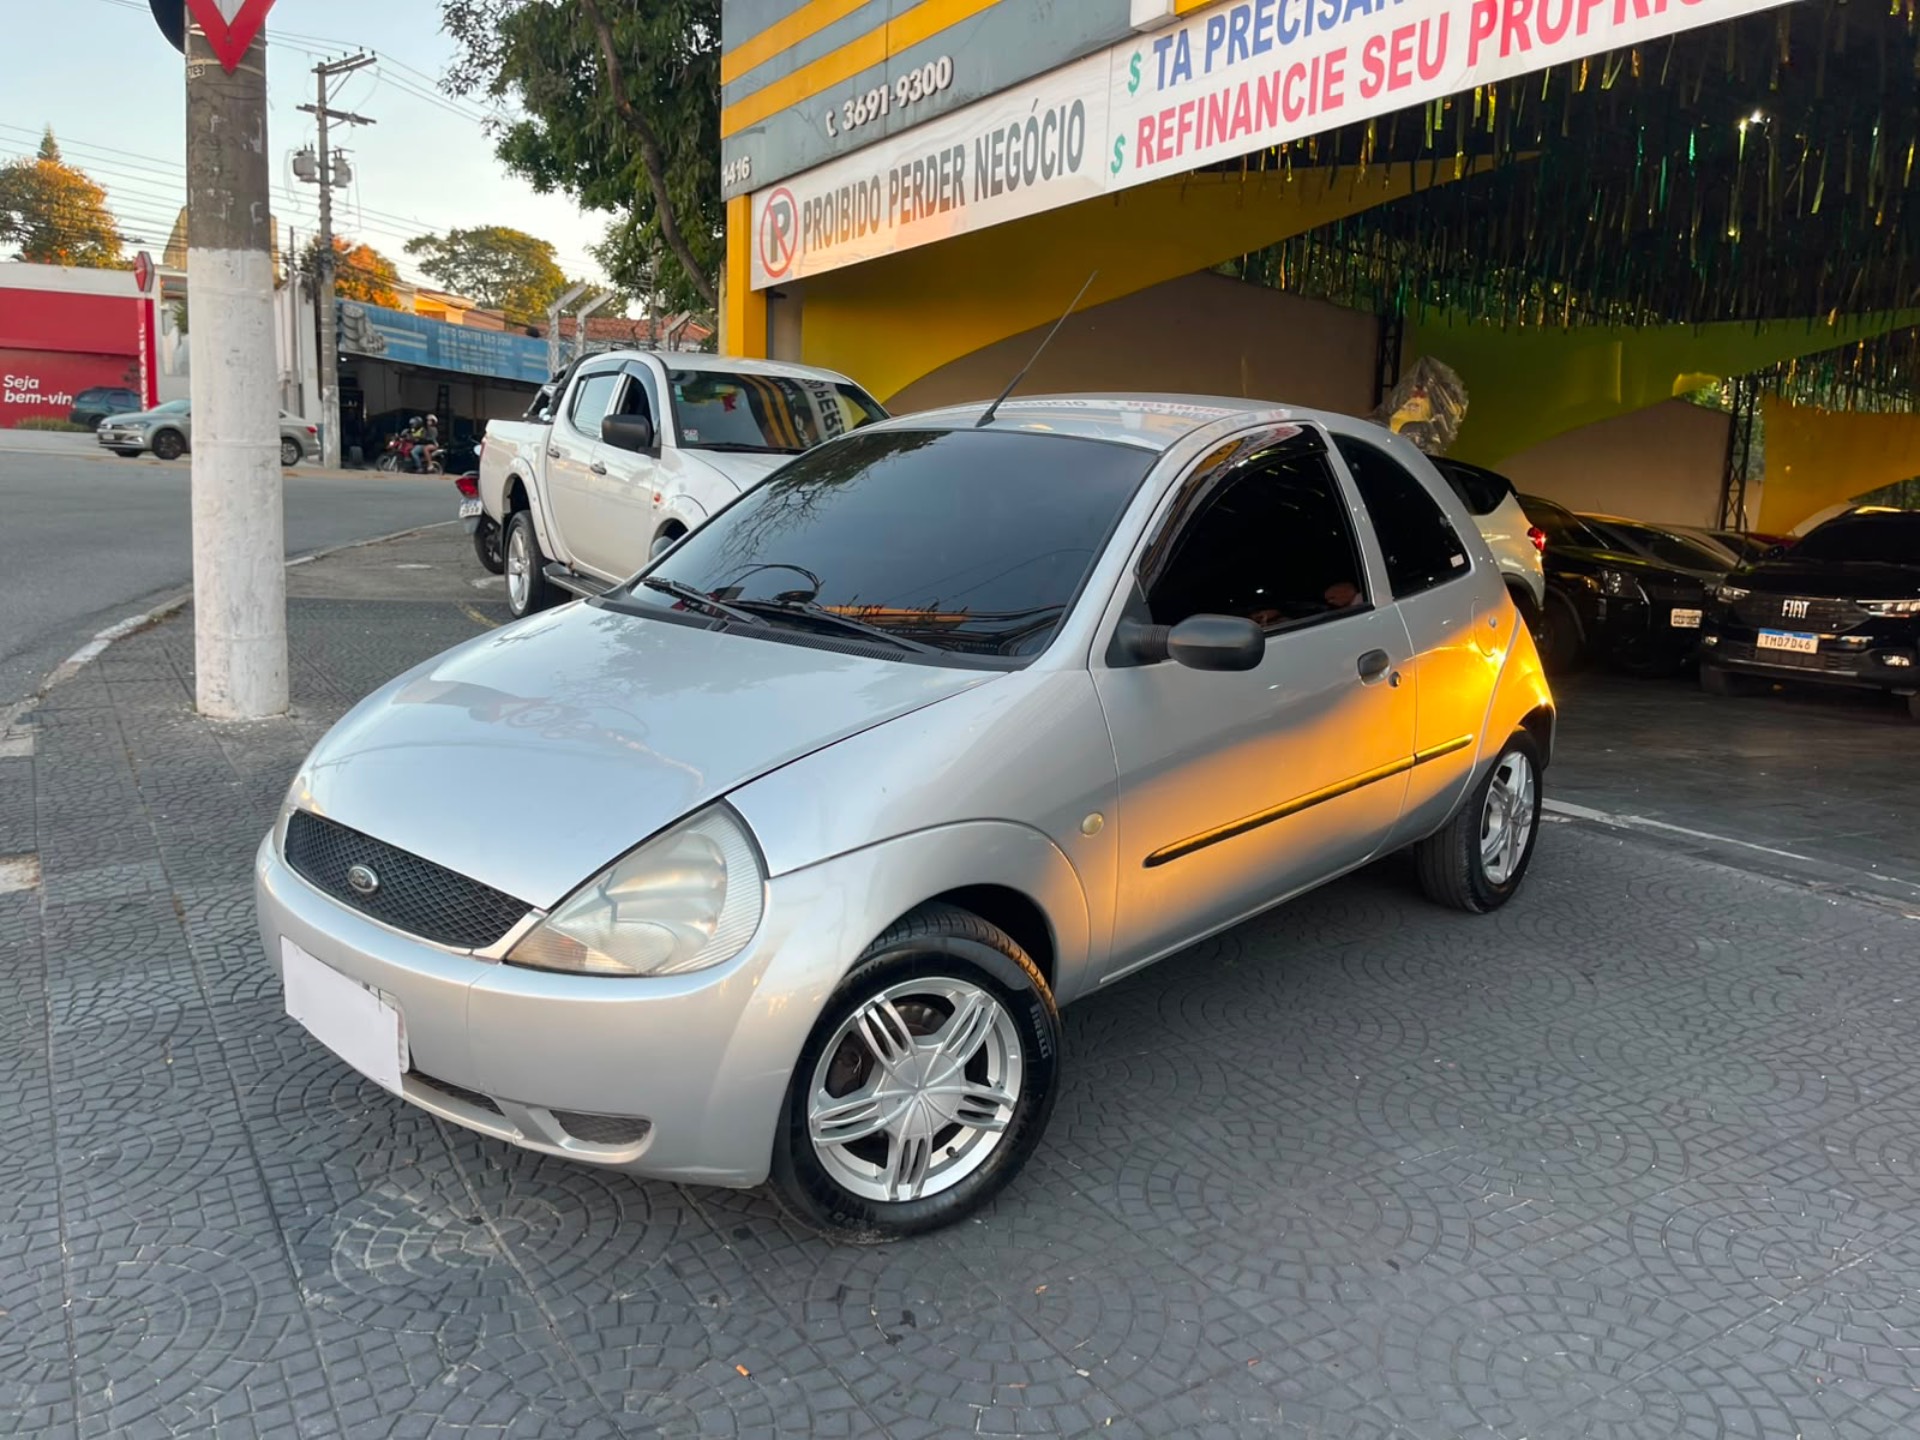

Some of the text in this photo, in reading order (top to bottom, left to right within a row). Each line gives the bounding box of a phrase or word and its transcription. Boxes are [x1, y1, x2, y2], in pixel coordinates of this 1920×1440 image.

[1153, 28, 1193, 92] TA
[841, 55, 954, 132] 3691-9300
[1135, 46, 1348, 169] REFINANCIE
[1359, 11, 1450, 99] SEU
[723, 155, 751, 187] 1416
[803, 175, 881, 255] PROIBIDO
[888, 143, 966, 229] PERDER
[974, 98, 1086, 202] NEGÓCIO
[3, 374, 39, 391] Seja
[4, 390, 77, 408] bem-vin
[1781, 599, 1810, 619] FIAT
